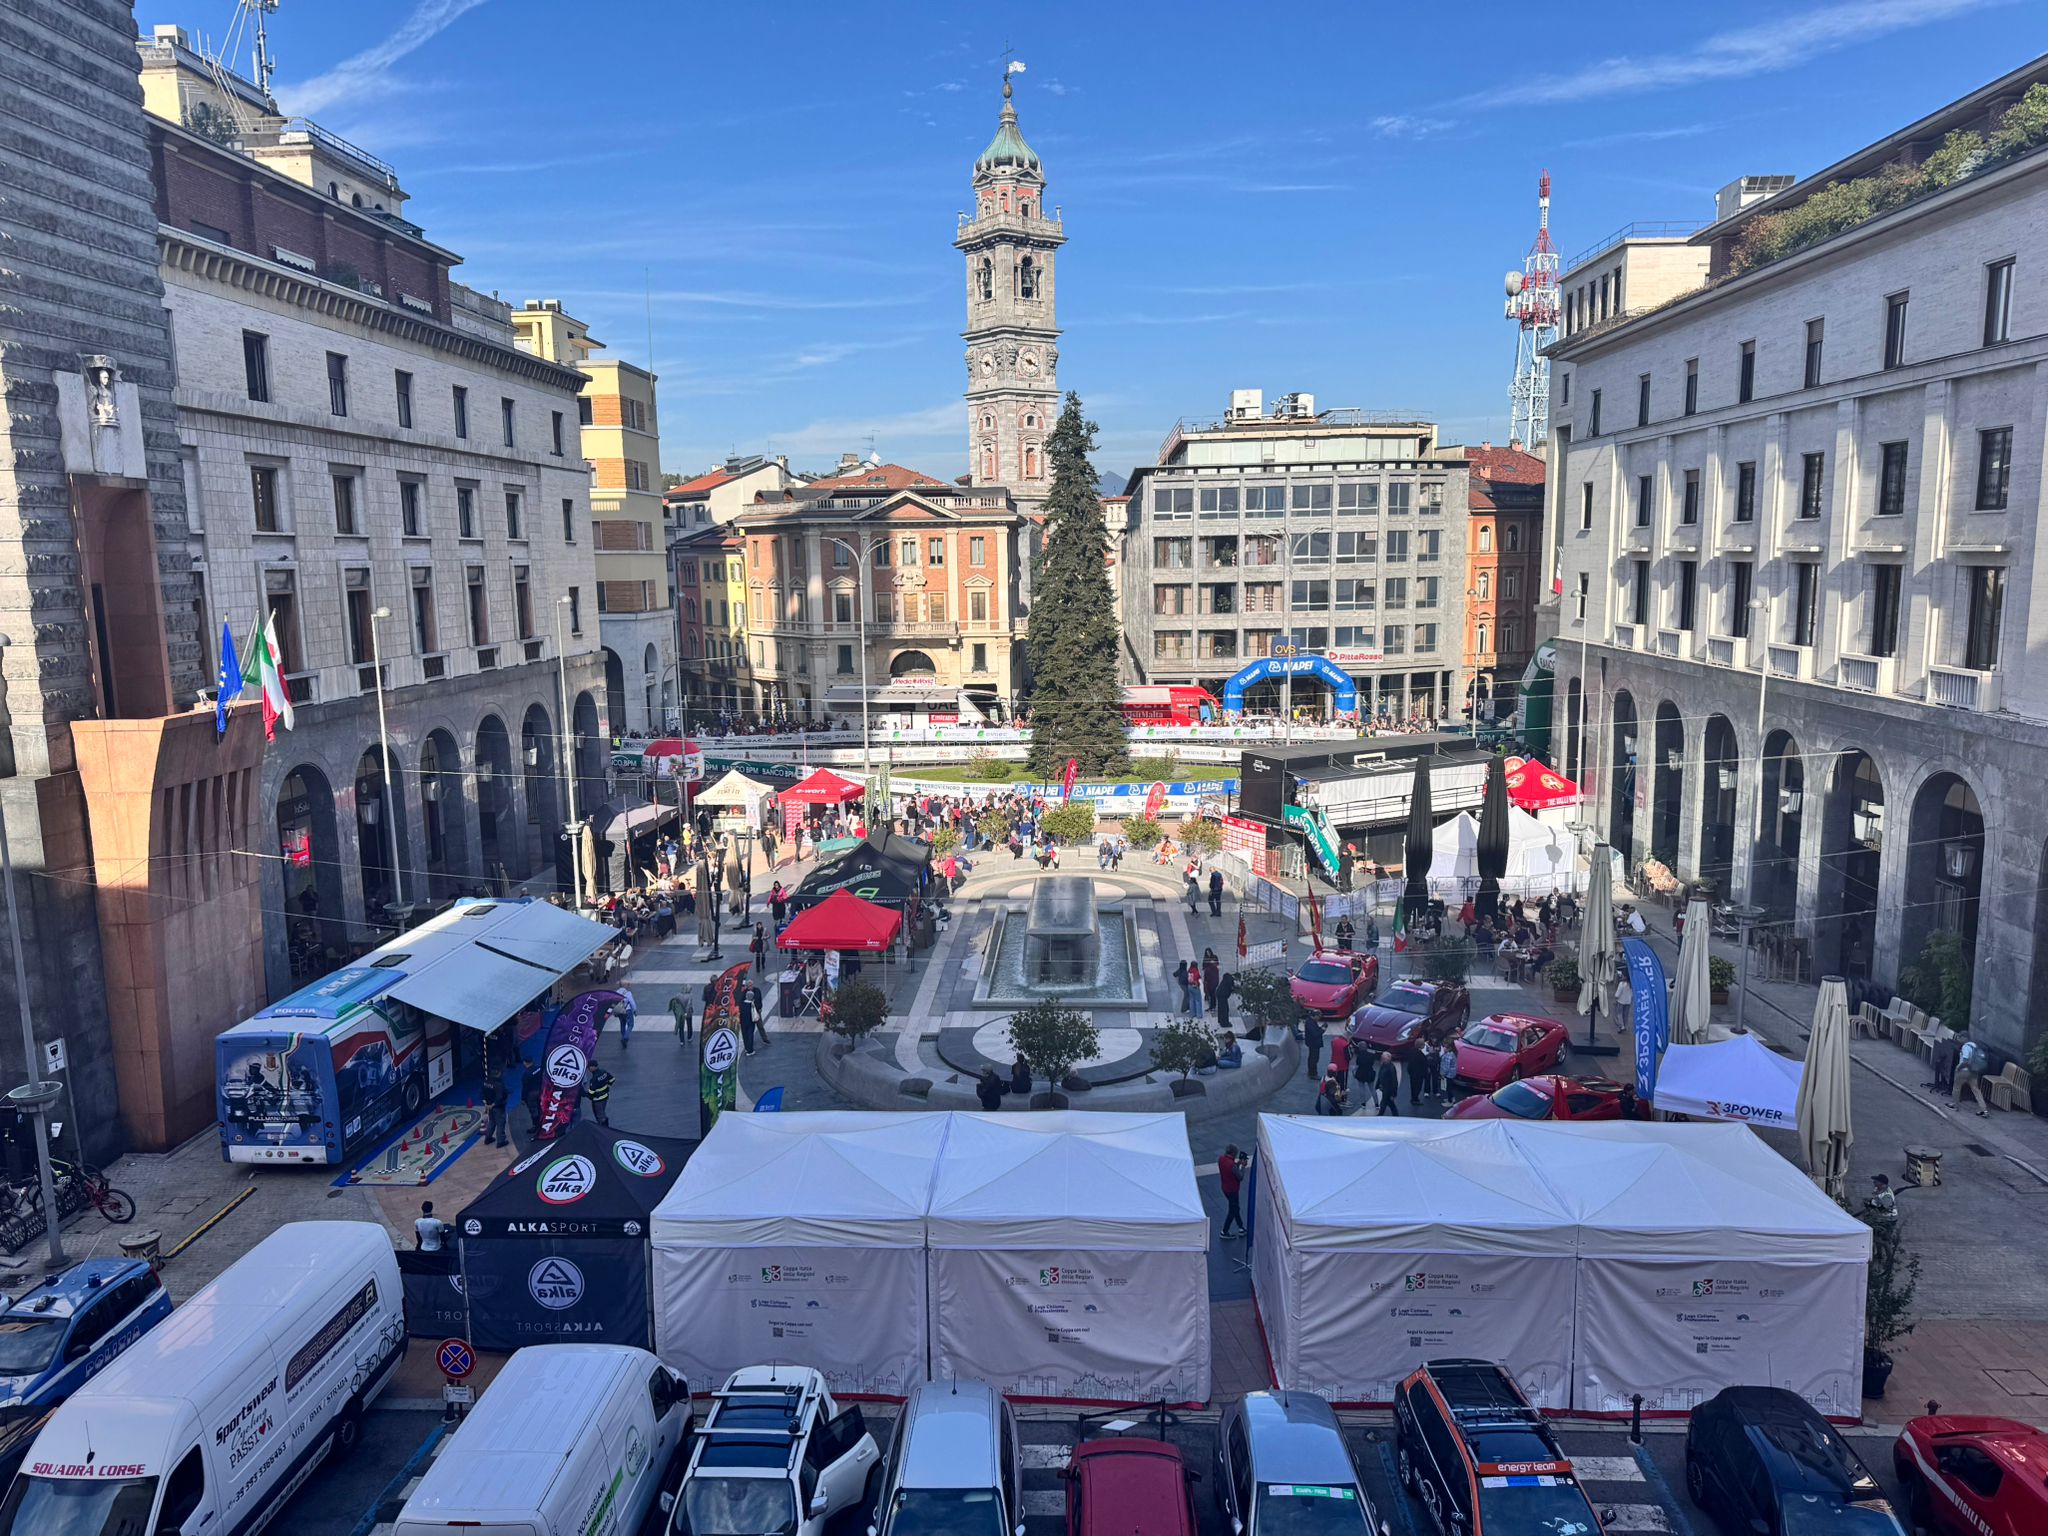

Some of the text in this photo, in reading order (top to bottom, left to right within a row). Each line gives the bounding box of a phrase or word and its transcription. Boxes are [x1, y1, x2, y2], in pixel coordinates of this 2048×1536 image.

[1275, 645, 1296, 654] OVS
[1339, 653, 1383, 661] PittaRosso
[1283, 661, 1314, 671] MAPEI
[1245, 668, 1261, 681] MAPEI
[927, 702, 959, 710] UAE
[746, 766, 759, 774] BPM
[762, 768, 784, 777] BANCO
[1085, 786, 1115, 795] MAPEI
[718, 976, 734, 1026] SPORT
[569, 994, 598, 1044] SPORT
[709, 1052, 732, 1065] alka
[552, 1067, 578, 1081] alka
[541, 1091, 563, 1132] ALKA
[1722, 1103, 1783, 1120] 3POWER
[638, 1154, 656, 1173] alka
[544, 1182, 582, 1194] alka
[85, 1325, 141, 1378] POLIZIA
[216, 1375, 279, 1447] Sportswear
[291, 1423, 305, 1441] MTB
[327, 1376, 348, 1403] STRADA
[230, 1408, 268, 1451] Cycling
[31, 1462, 146, 1476] SQUADRA CORSE
[1498, 1462, 1556, 1473] energy team
[1954, 1494, 1979, 1526] VIGILI
